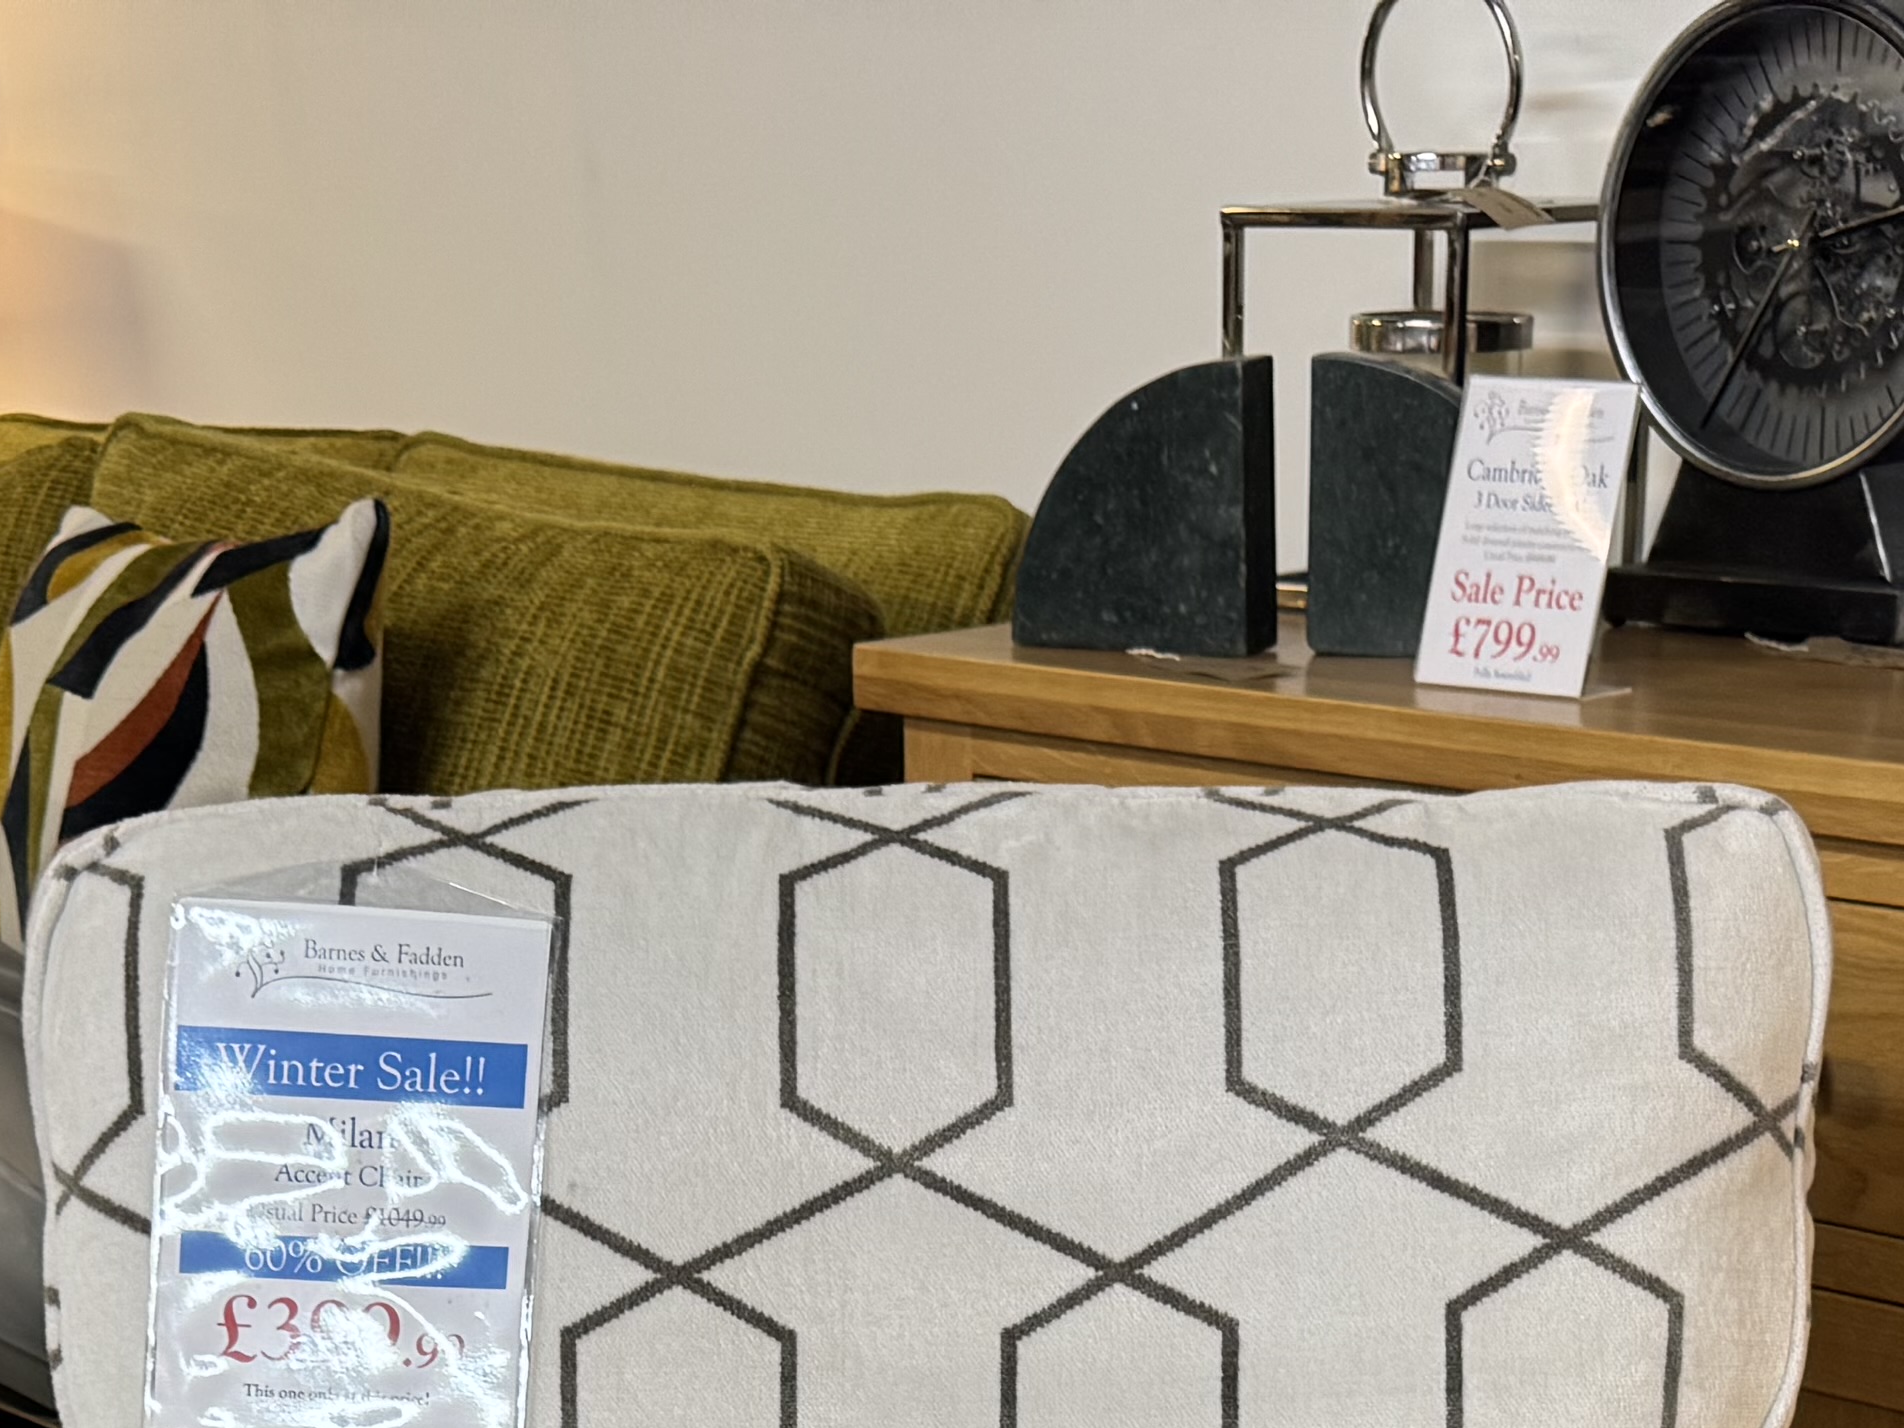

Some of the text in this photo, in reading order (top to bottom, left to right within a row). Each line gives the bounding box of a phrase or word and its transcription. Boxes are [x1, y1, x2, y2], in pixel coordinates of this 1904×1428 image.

[1466, 458, 1560, 488] Cambri
[1450, 568, 1584, 612] Sale Price
[1448, 615, 1561, 664] £799.99
[303, 937, 465, 969] Barnes & Fadden
[317, 963, 356, 977] Home
[217, 1042, 486, 1097] Winter Sale!!
[257, 1203, 304, 1223] sual
[311, 1203, 359, 1225] Price
[244, 1236, 323, 1274] 60%
[242, 1383, 277, 1400] This
[278, 1388, 306, 1401] one
